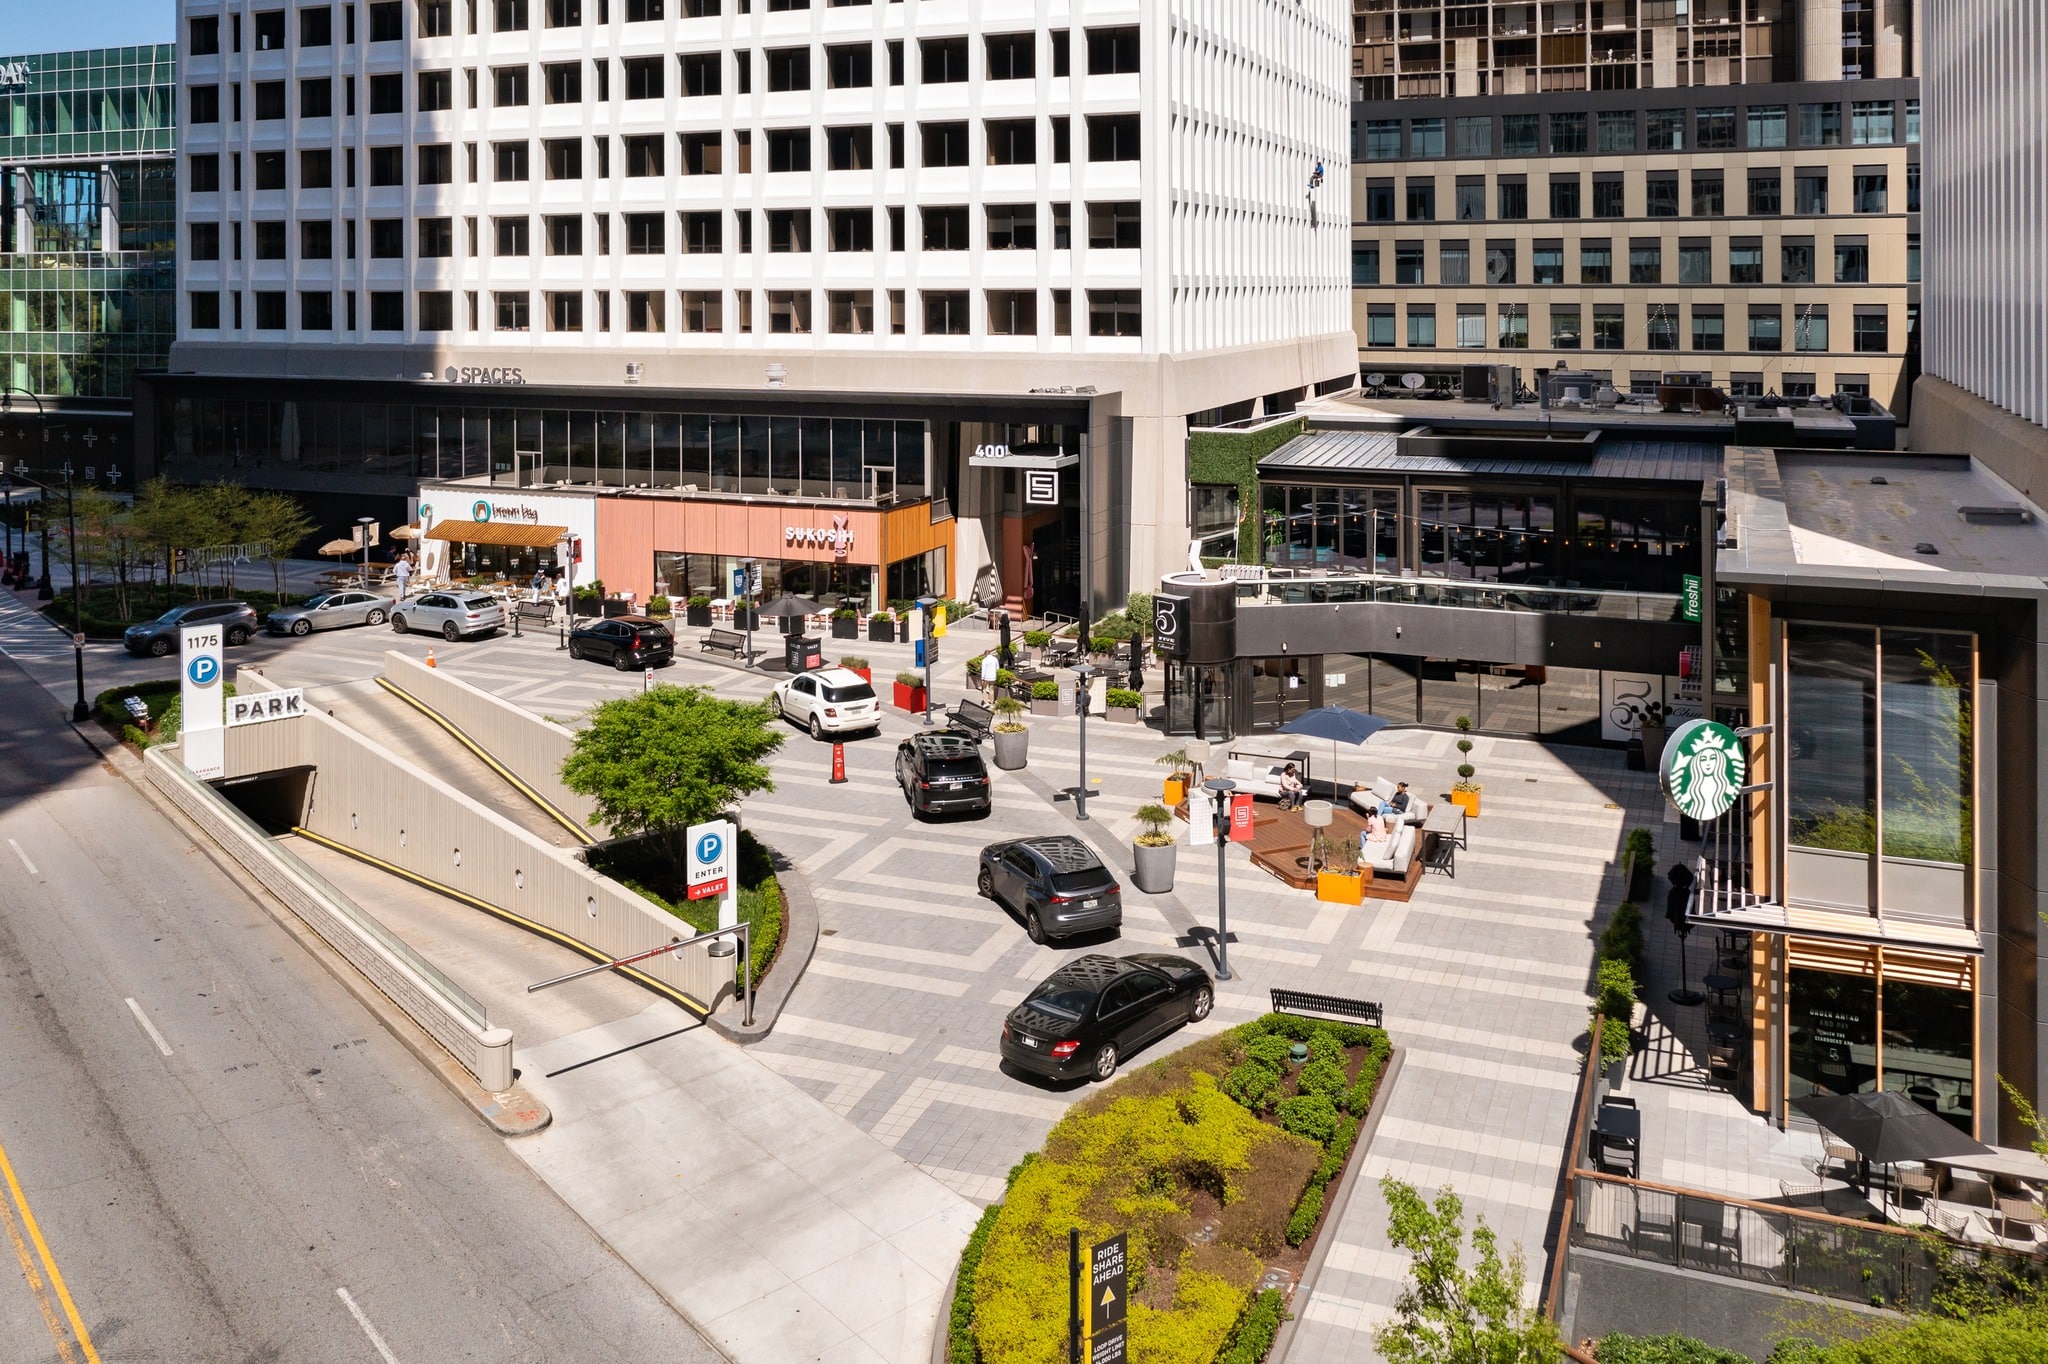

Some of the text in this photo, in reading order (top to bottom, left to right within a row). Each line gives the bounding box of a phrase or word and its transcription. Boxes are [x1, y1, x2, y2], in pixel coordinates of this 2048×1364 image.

[975, 444, 1005, 458] 400
[785, 527, 854, 543] SUKOSHI
[1685, 578, 1698, 617] freshii
[187, 634, 218, 649] 1175
[234, 694, 300, 720] PARK
[695, 866, 724, 879] ENTER
[701, 883, 725, 895] VALET
[1097, 1243, 1119, 1261] RIDE
[1092, 1252, 1124, 1275] SHARE
[1092, 1264, 1124, 1286] AHEAD
